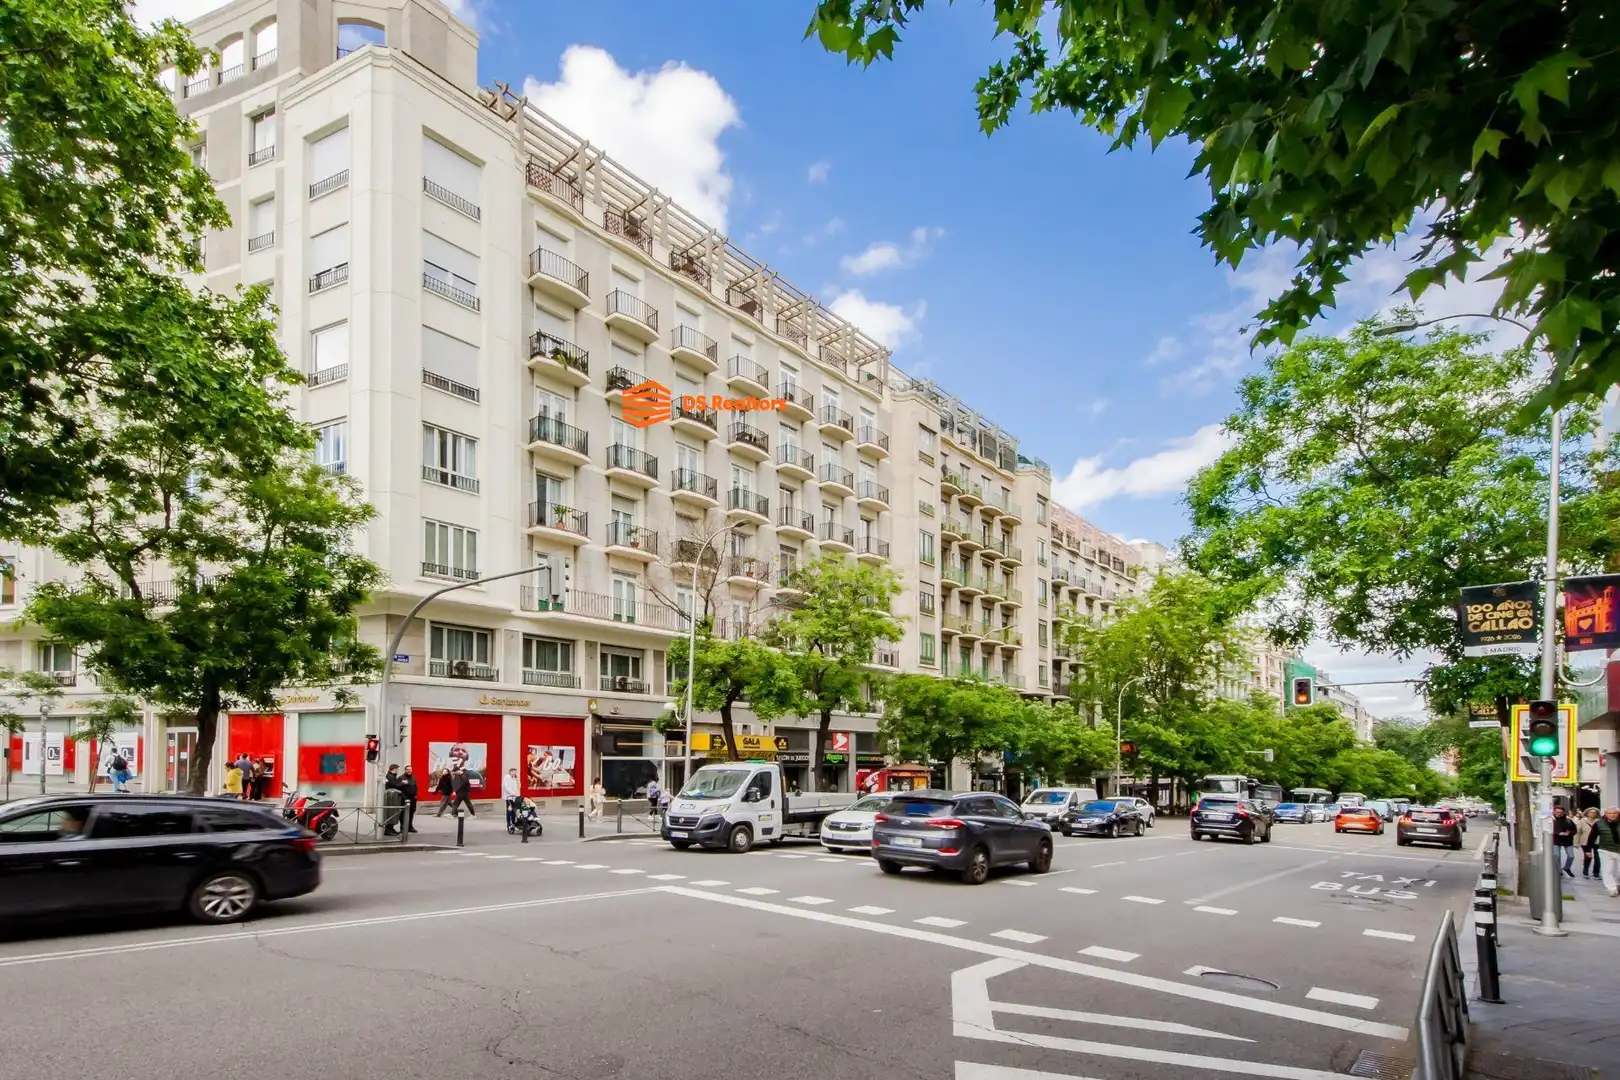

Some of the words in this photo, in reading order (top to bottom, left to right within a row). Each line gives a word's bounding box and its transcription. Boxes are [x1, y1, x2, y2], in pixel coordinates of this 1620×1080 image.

[1466, 603, 1494, 613] 100
[1496, 600, 1533, 611] AÑOS
[1467, 613, 1483, 622] DE
[1486, 611, 1514, 620] CINE
[1516, 608, 1533, 617] EN
[1467, 617, 1534, 633] CALLAO
[490, 697, 531, 707] Santander
[743, 737, 761, 746] GALA
[1340, 871, 1437, 887] TAXI
[1309, 881, 1419, 899] BUS
